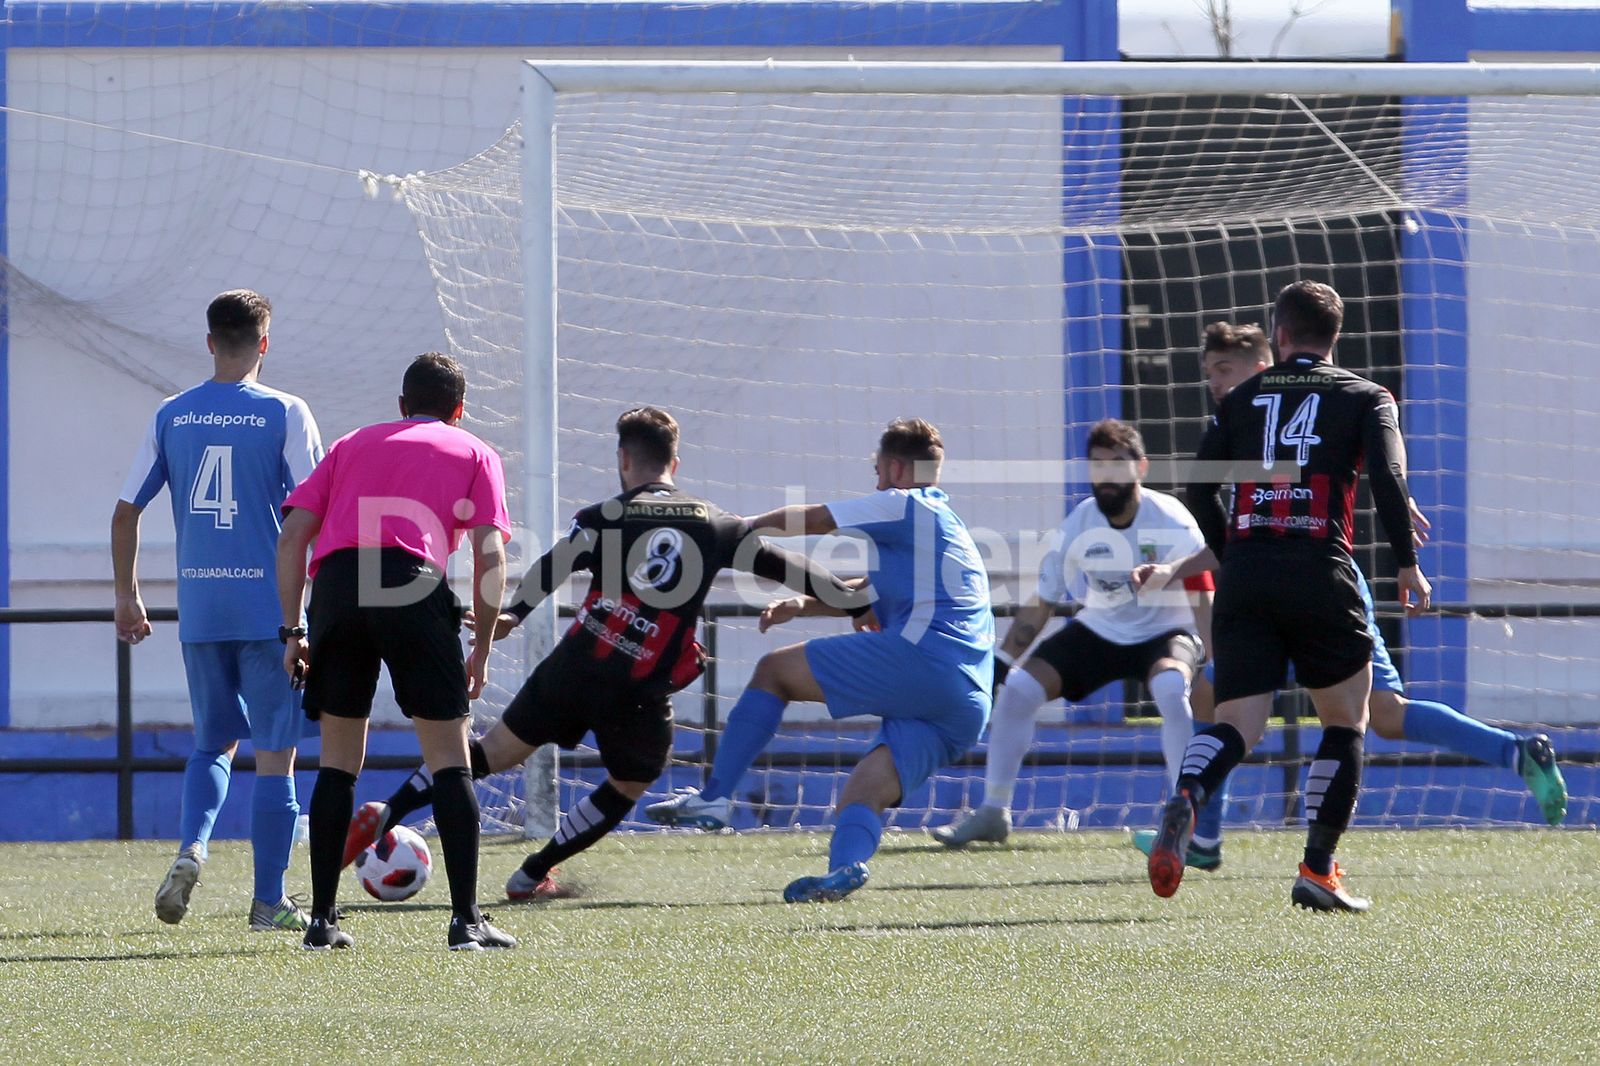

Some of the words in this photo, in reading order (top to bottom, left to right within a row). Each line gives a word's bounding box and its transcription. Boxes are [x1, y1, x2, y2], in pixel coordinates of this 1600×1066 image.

[173, 411, 266, 428] saludeporte
[1252, 392, 1322, 470] 14
[189, 445, 239, 530] 4
[1250, 488, 1314, 505] Beiman
[629, 527, 683, 591] 8
